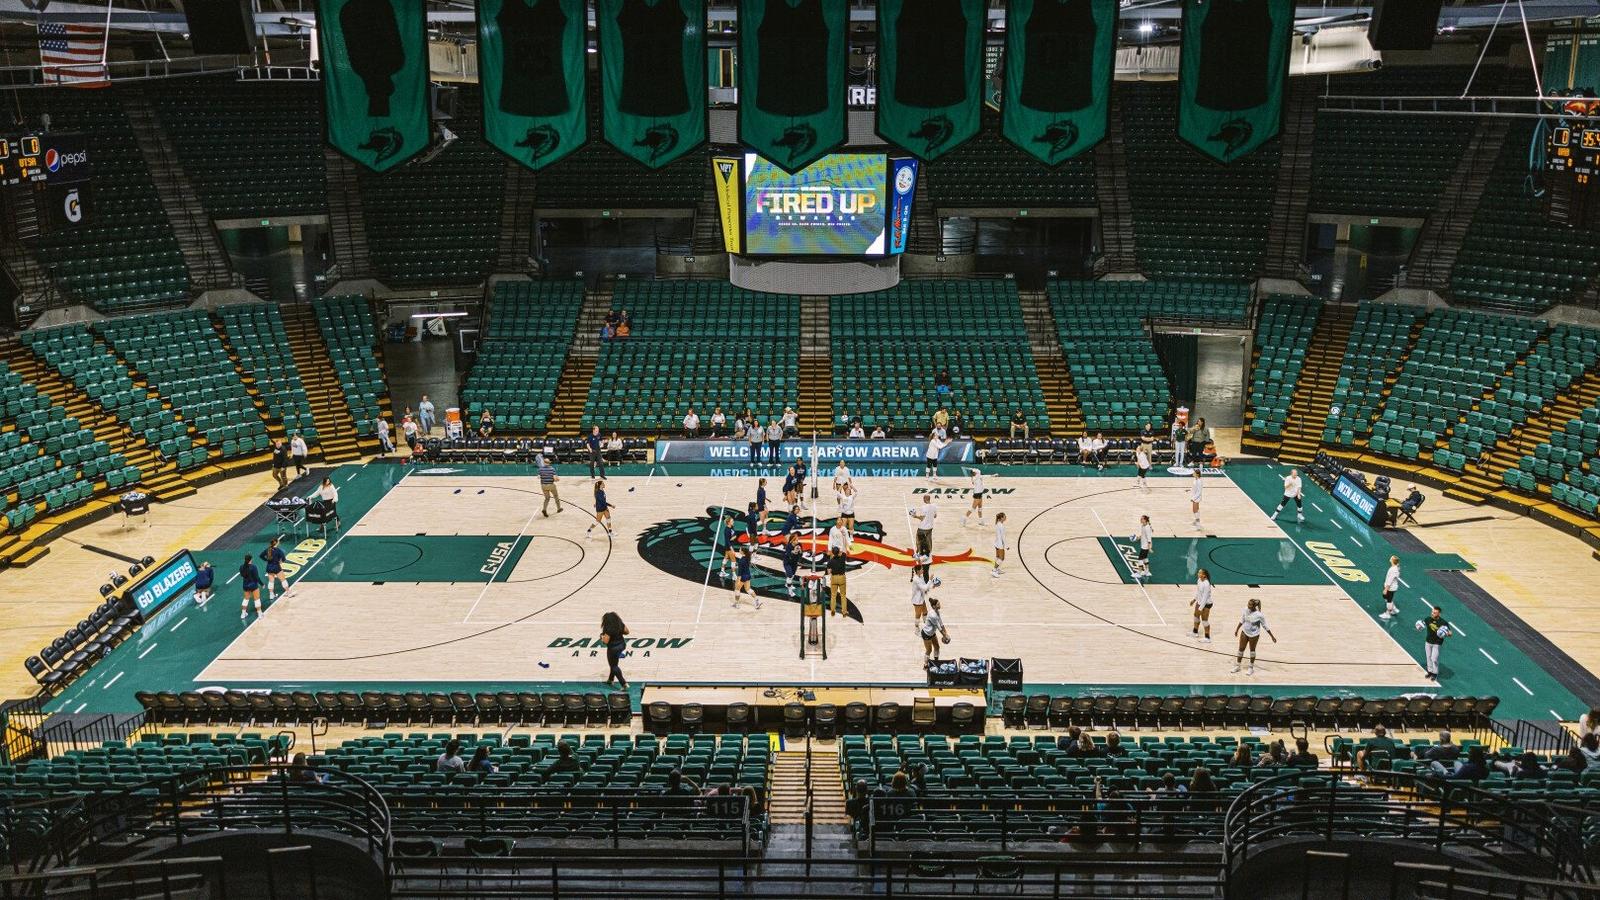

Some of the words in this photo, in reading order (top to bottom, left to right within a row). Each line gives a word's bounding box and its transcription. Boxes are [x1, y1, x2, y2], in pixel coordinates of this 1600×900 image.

[61, 150, 87, 168] pepsi
[756, 192, 834, 214] FIRED
[839, 192, 876, 214] UP
[784, 446, 803, 458] TO
[872, 446, 920, 458] ARENA
[1337, 481, 1353, 498] WIN
[1349, 491, 1361, 505] AS
[1359, 500, 1374, 516] ONE
[1305, 541, 1371, 582] UAB
[137, 590, 154, 609] GO
[152, 561, 193, 598] BLAZERS
[711, 801, 740, 815] 115
[880, 804, 905, 816] 116
